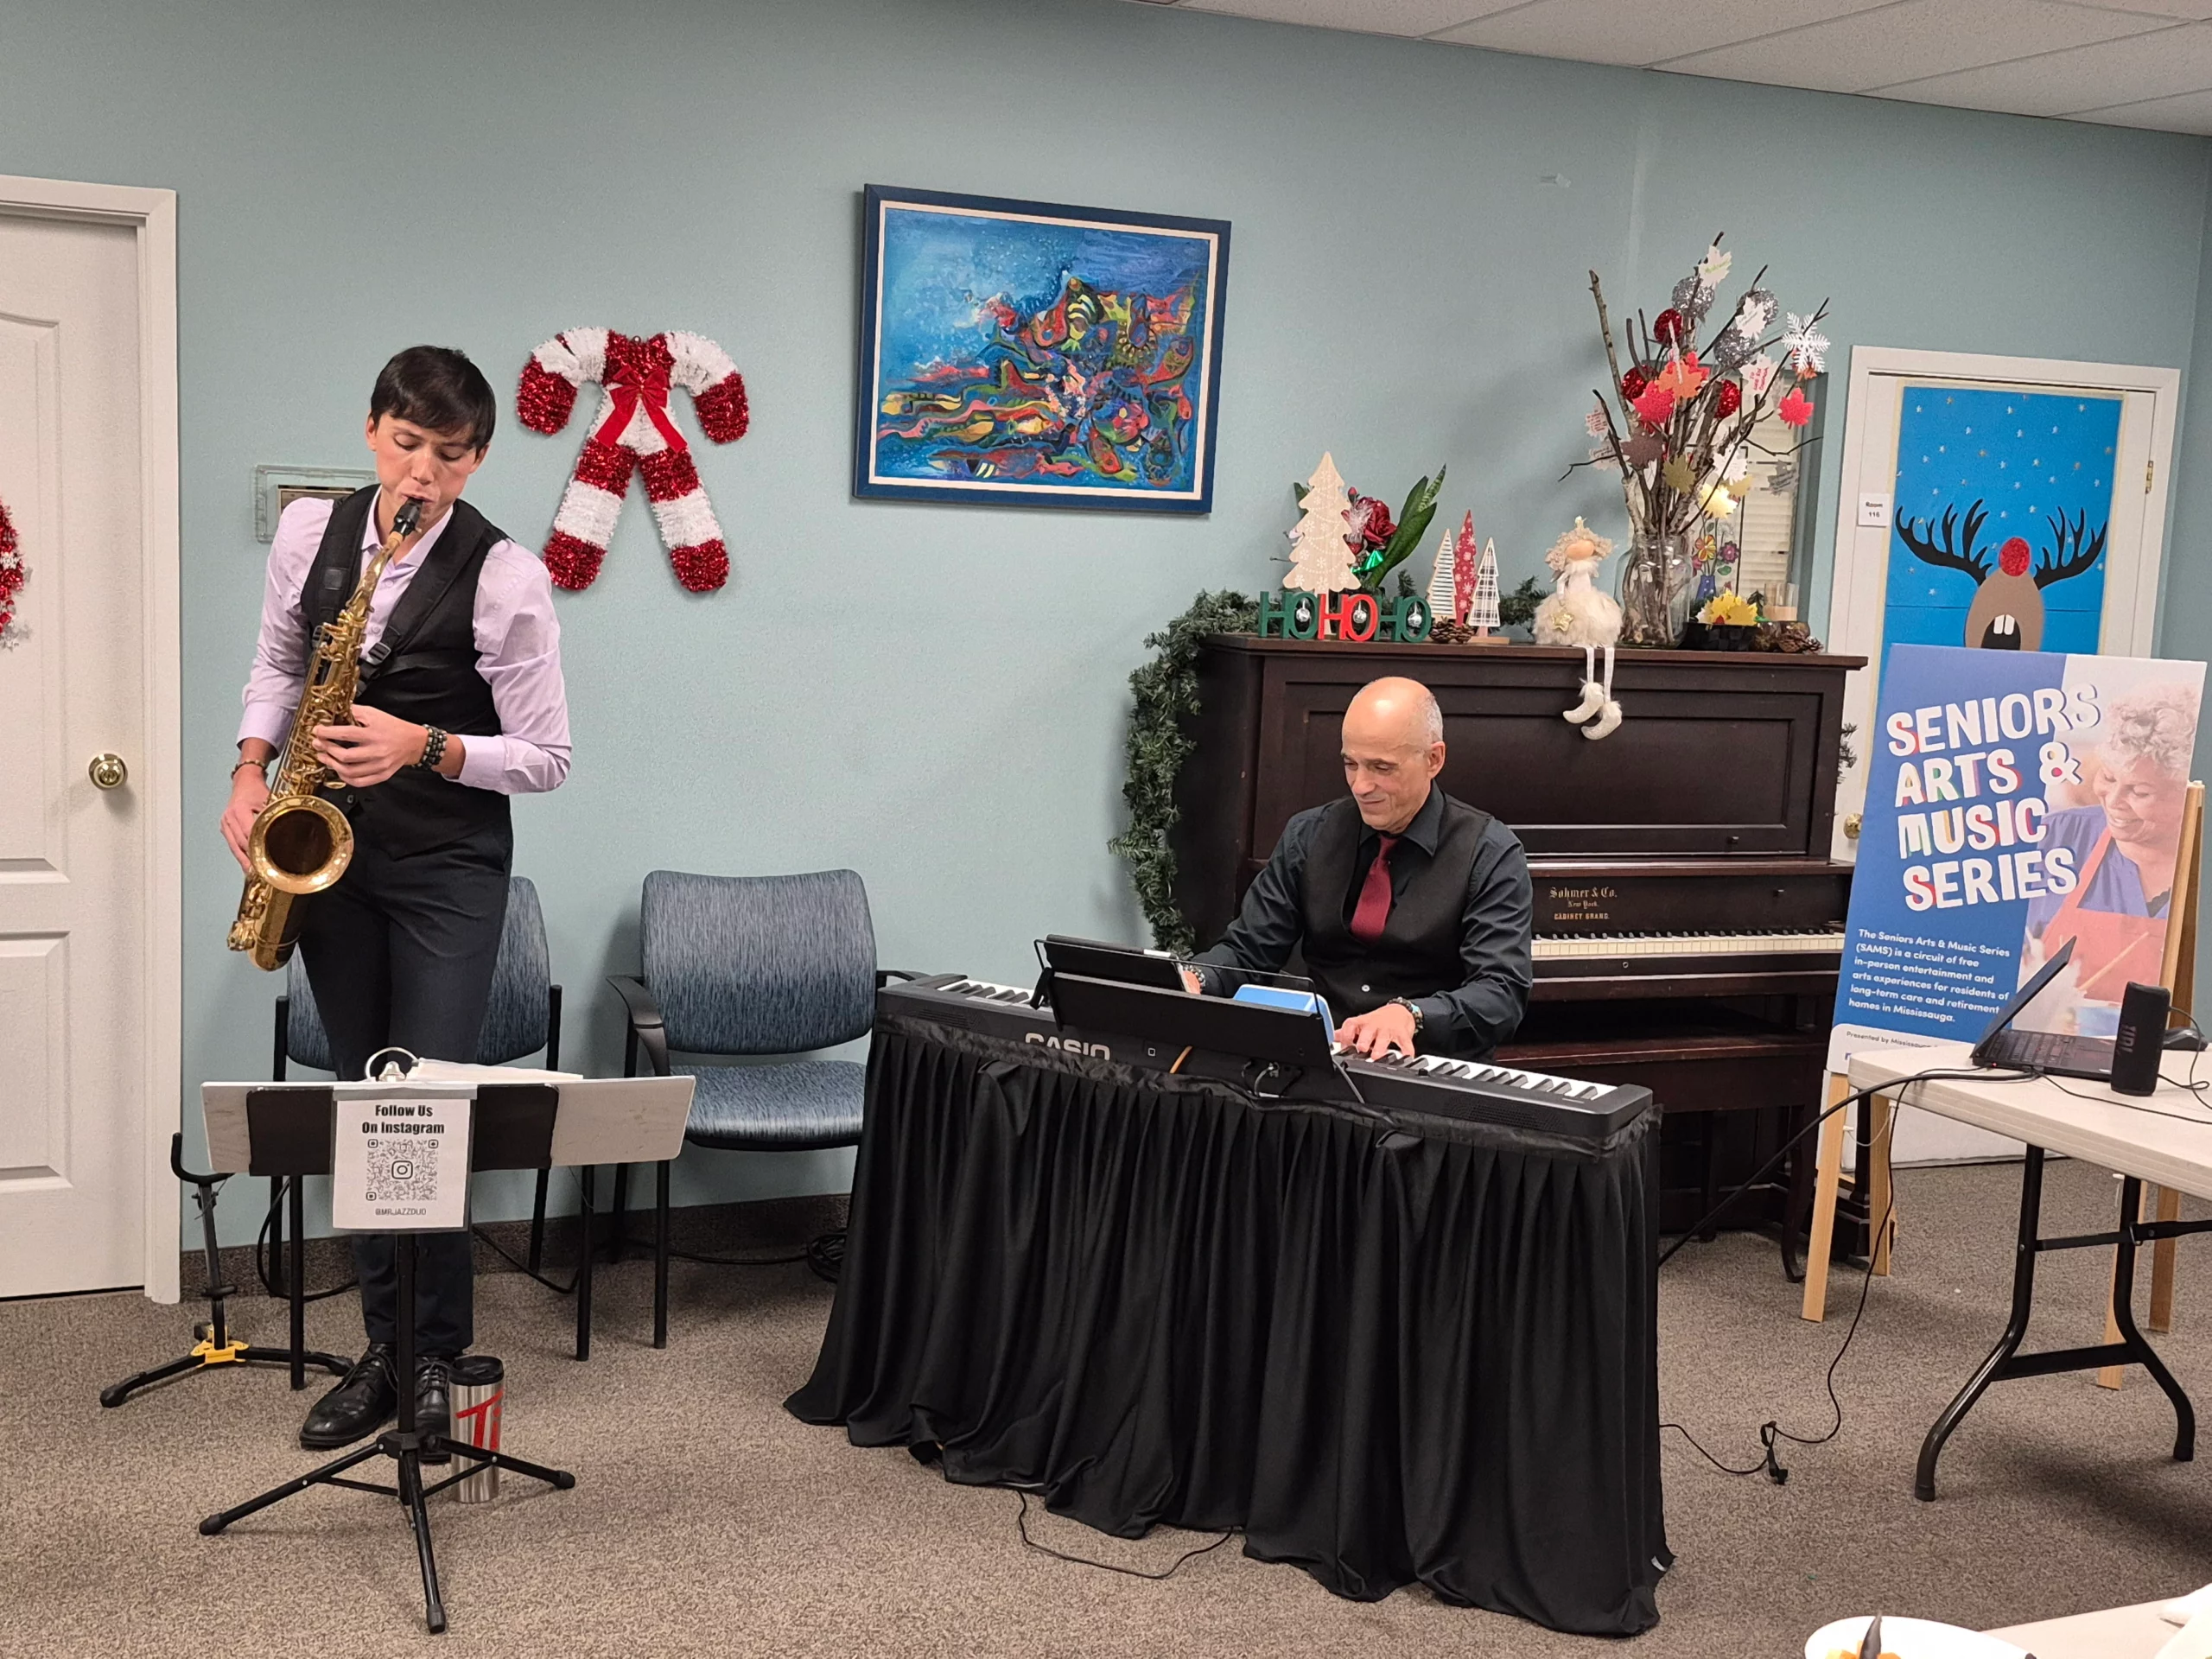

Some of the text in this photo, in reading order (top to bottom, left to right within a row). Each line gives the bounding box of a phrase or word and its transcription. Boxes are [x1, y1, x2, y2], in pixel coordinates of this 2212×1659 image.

[1886, 683, 2101, 757] SENIORS
[1895, 741, 2082, 808] ARTS &
[1897, 798, 2048, 859] MUSIC
[1591, 887, 1599, 898] &
[1903, 848, 2079, 912] SERIES
[1856, 943, 1893, 957] (SAMS)
[1894, 948, 1902, 957] is
[1913, 951, 1944, 963] circuit
[1946, 955, 1956, 964] of
[1958, 957, 1980, 968] free
[1859, 929, 2010, 957] The Seniors Arts & Music Series
[1854, 957, 1994, 984] in-person entertainment and
[1850, 984, 1999, 1014] long-term care and retirement
[1852, 972, 2010, 1001] arts experiences for residents of
[1848, 998, 1956, 1022] homes in Mississauga.
[1847, 1031, 1879, 1041] Presented
[375, 1104, 434, 1117] Follow Us
[362, 1122, 445, 1135] On Instagram
